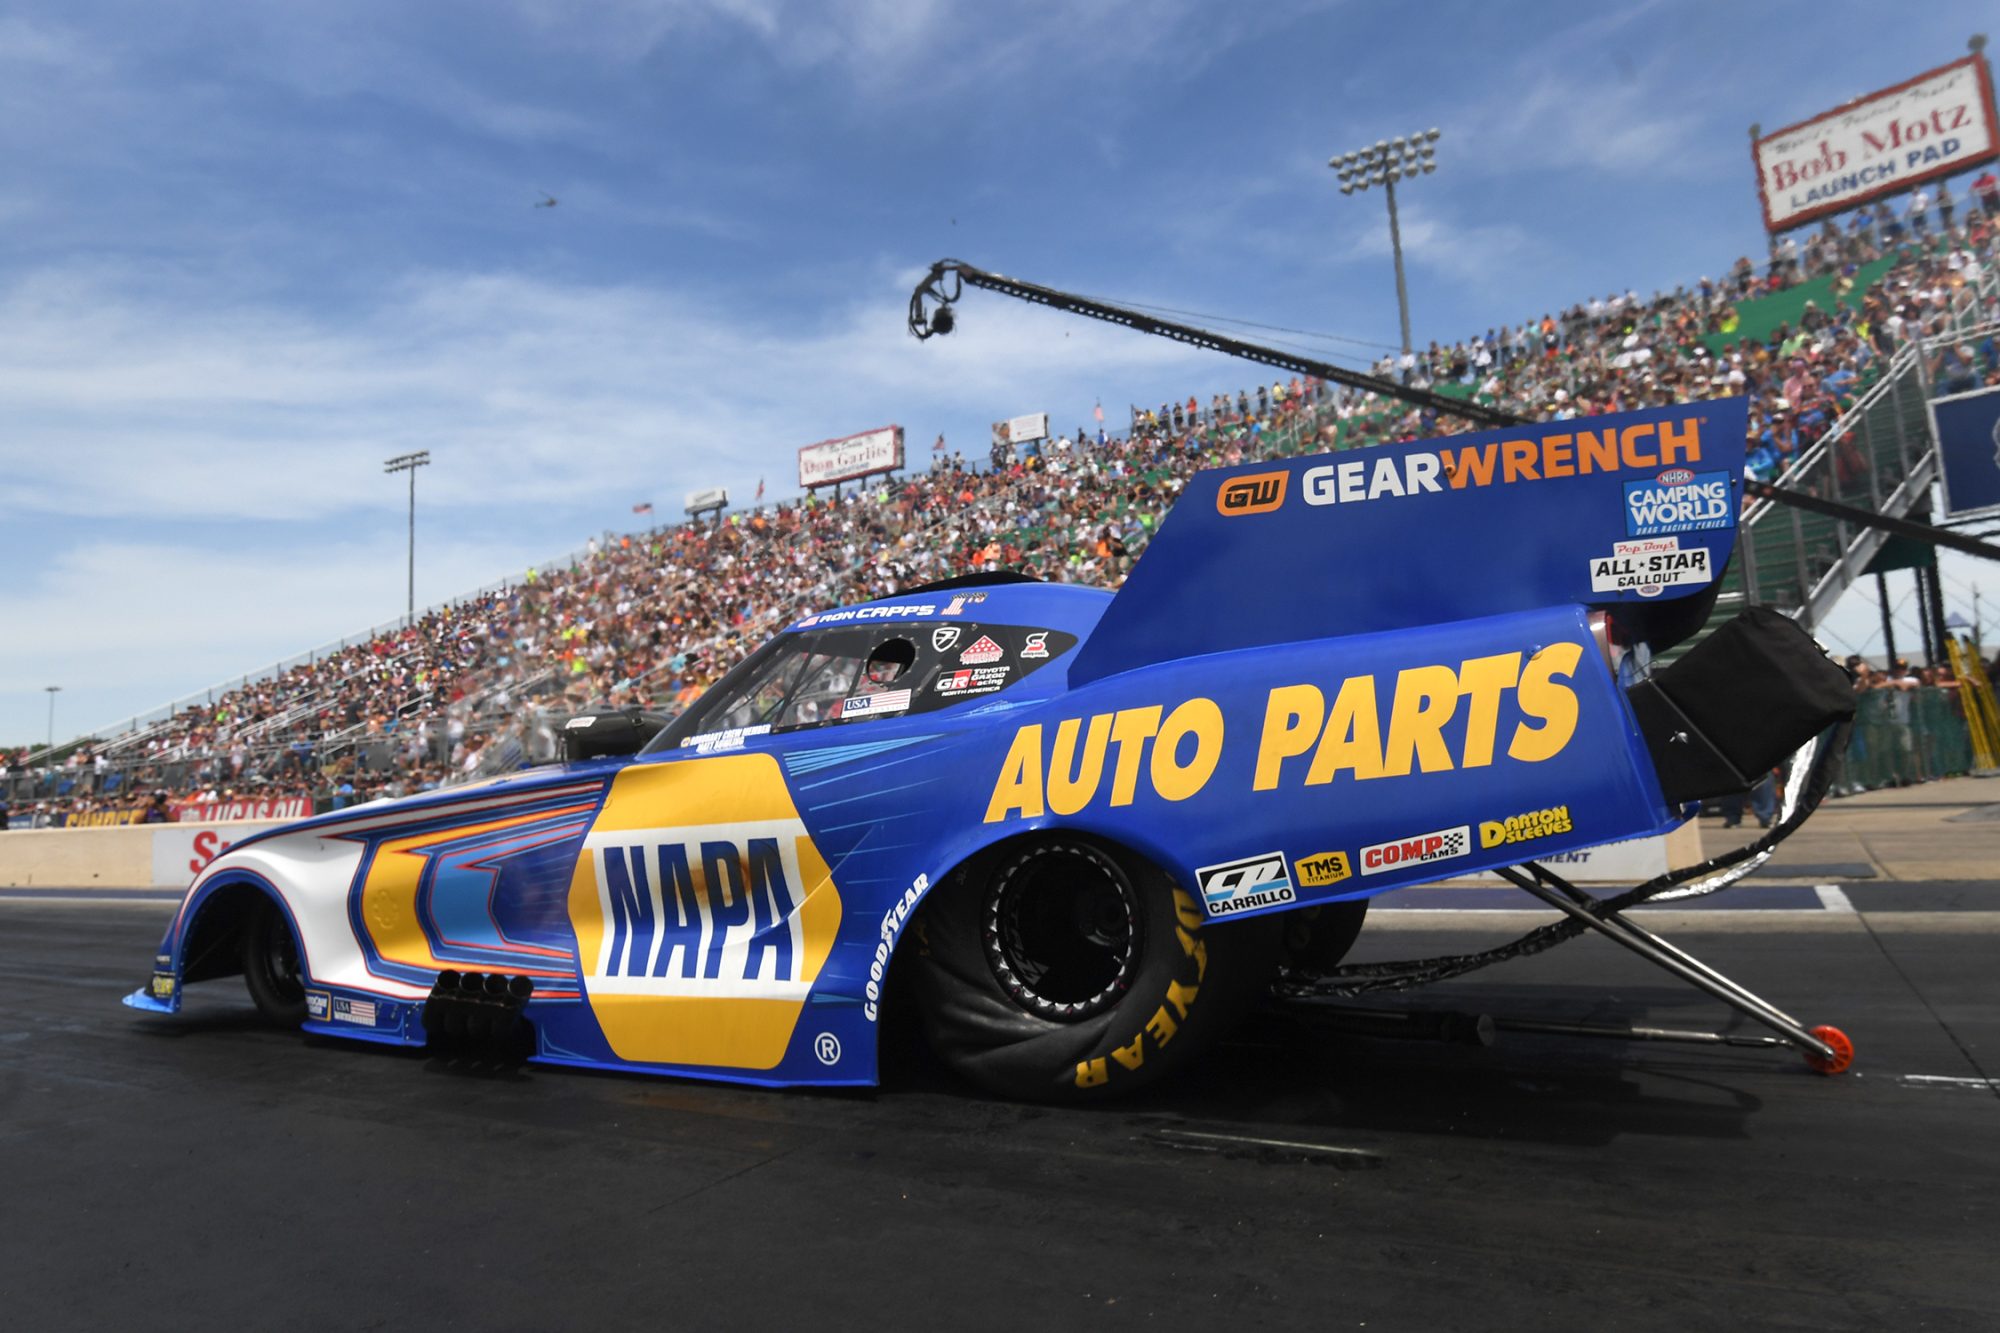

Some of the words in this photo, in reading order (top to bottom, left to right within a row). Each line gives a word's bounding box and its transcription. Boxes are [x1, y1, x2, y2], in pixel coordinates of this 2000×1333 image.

[1771, 140, 1846, 191] Bob
[1861, 104, 1972, 159] Motz
[1791, 160, 1896, 208] LAUNCH
[1906, 138, 1961, 168] PAD
[1302, 417, 1701, 507] GEARWRENCH
[1660, 471, 1690, 484] NHRA
[1628, 482, 1726, 507] CAMPING
[1630, 499, 1728, 526] WORLD
[1635, 526, 1658, 536] DRAG
[1661, 522, 1692, 534] RACING
[1695, 519, 1727, 530] SERIES
[1617, 544, 1641, 554] Pop
[1643, 541, 1676, 553] Boys
[1595, 559, 1636, 577] ALL
[1648, 551, 1706, 572] STAR
[819, 611, 856, 623] RON
[856, 605, 936, 619] CAPPS
[973, 666, 1010, 675] TOYOTA
[941, 689, 967, 697] NORTH
[967, 686, 1000, 694] AMERICA
[846, 699, 868, 710] USA
[983, 697, 1225, 823] AUTO
[1253, 642, 1585, 792] PARTS
[1505, 818, 1573, 844] SLEEVES
[1365, 836, 1444, 868] COMP
[1420, 847, 1459, 861] CAMS
[1302, 857, 1343, 877] TMS
[1307, 871, 1345, 884] TITANIUM
[602, 837, 795, 982] NAPA
[1209, 888, 1292, 914] CARRILLO
[864, 873, 929, 1022] GOODYEAR
[335, 1000, 350, 1012] USA
